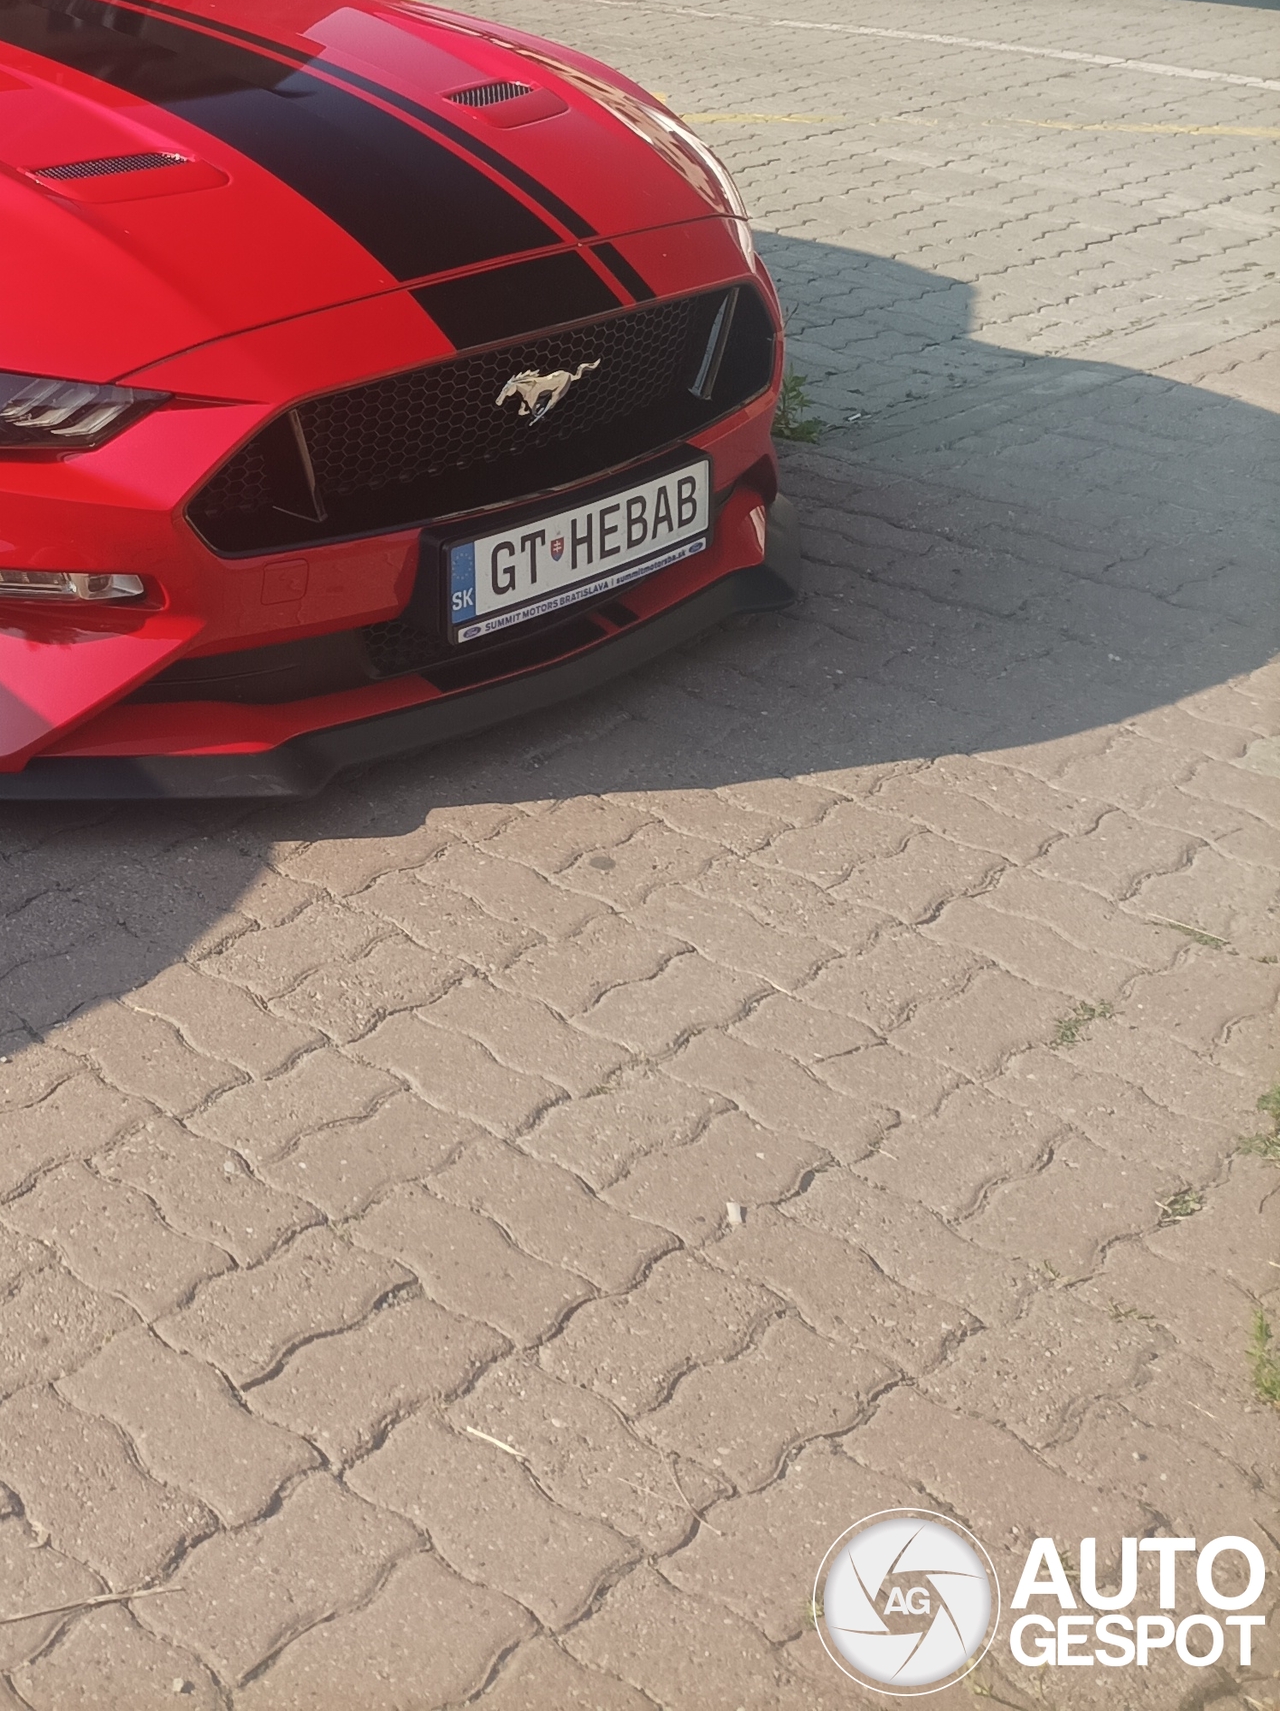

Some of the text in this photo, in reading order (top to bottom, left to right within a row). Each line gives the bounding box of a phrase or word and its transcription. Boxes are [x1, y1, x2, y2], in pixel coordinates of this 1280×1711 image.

[491, 475, 697, 595] GT HEBAB
[452, 588, 474, 611] SK
[485, 612, 522, 632] SUMMIT
[522, 599, 559, 619] MOTORS
[559, 580, 609, 605] BRATISLAVA
[616, 549, 686, 585] summitmotorsba.sk
